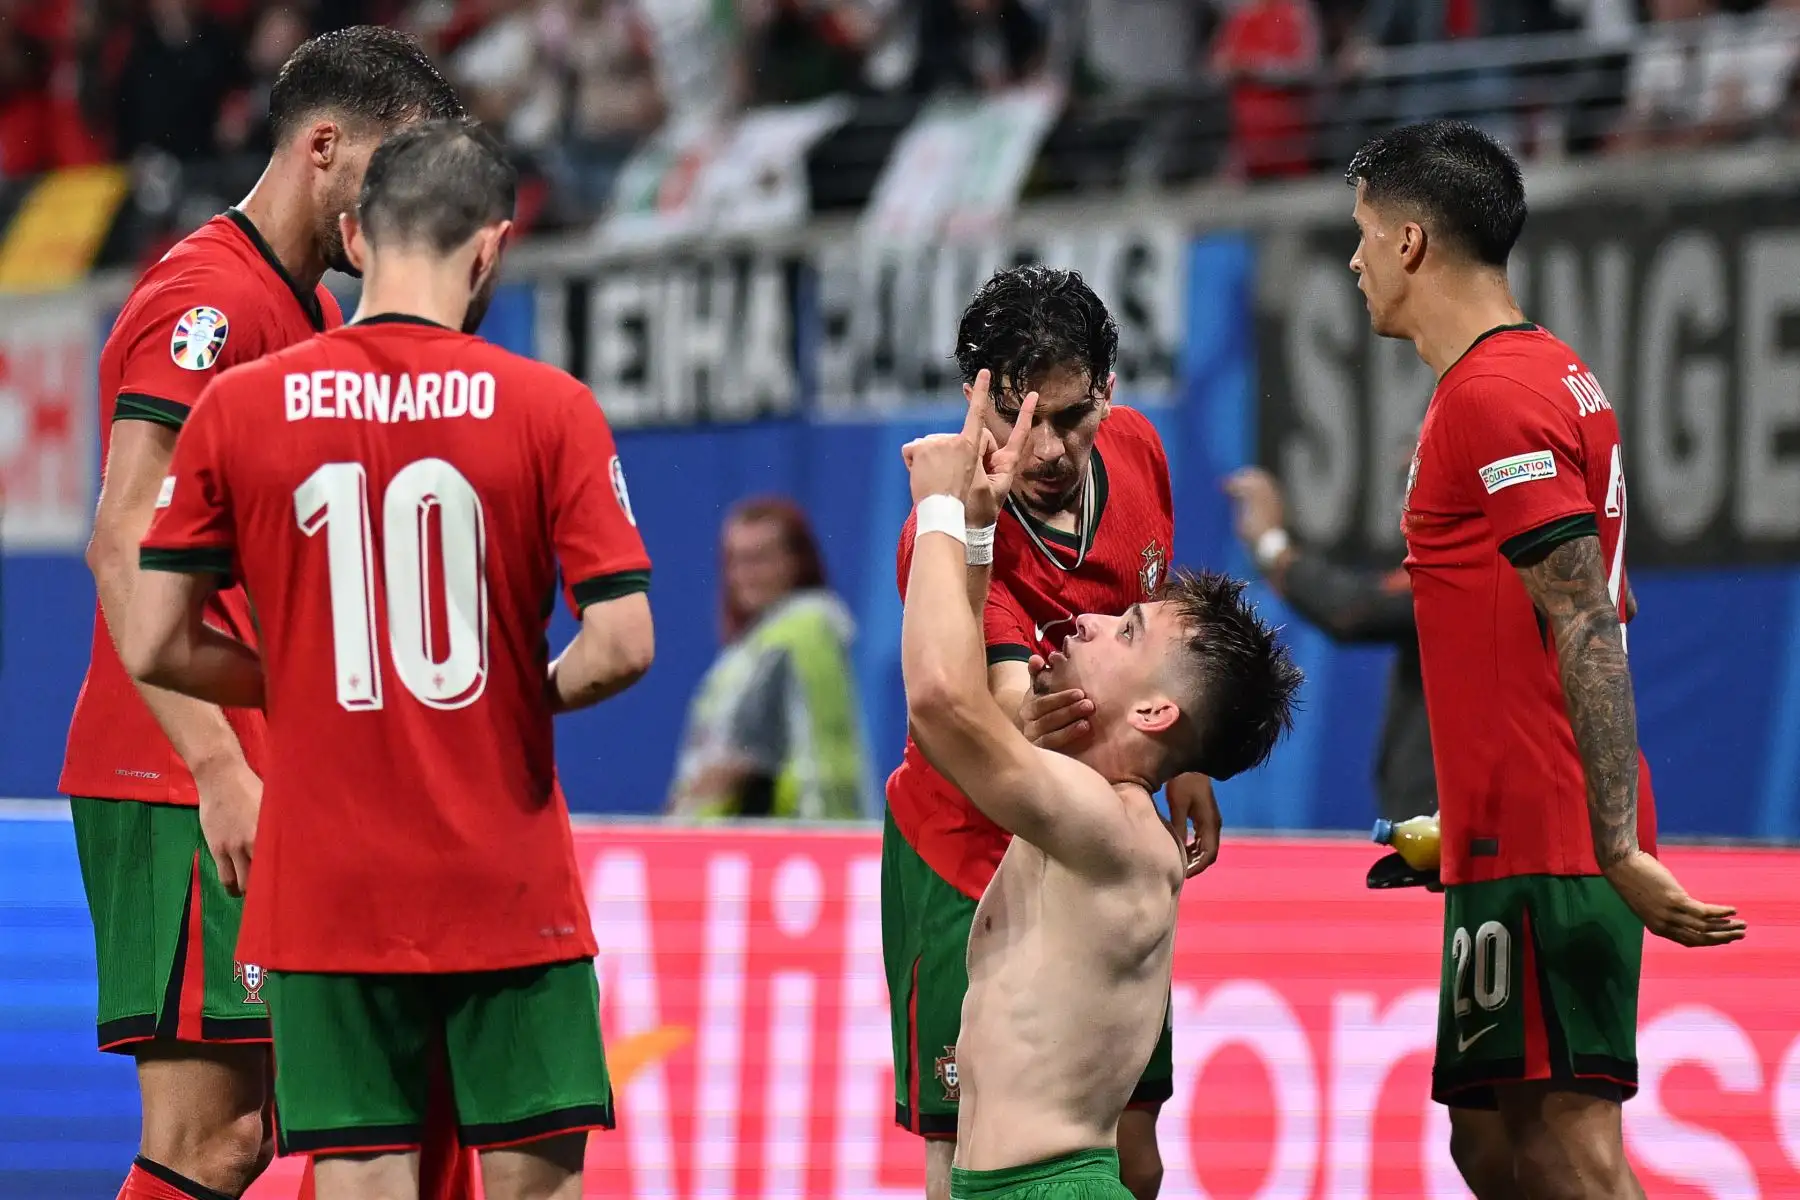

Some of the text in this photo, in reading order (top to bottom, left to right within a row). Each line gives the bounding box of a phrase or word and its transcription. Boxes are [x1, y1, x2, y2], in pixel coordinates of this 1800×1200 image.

[284, 370, 497, 423] BERNARDO
[1483, 460, 1553, 485] FOUNDATION
[293, 457, 489, 712] 10
[1452, 920, 1511, 1018] 20
